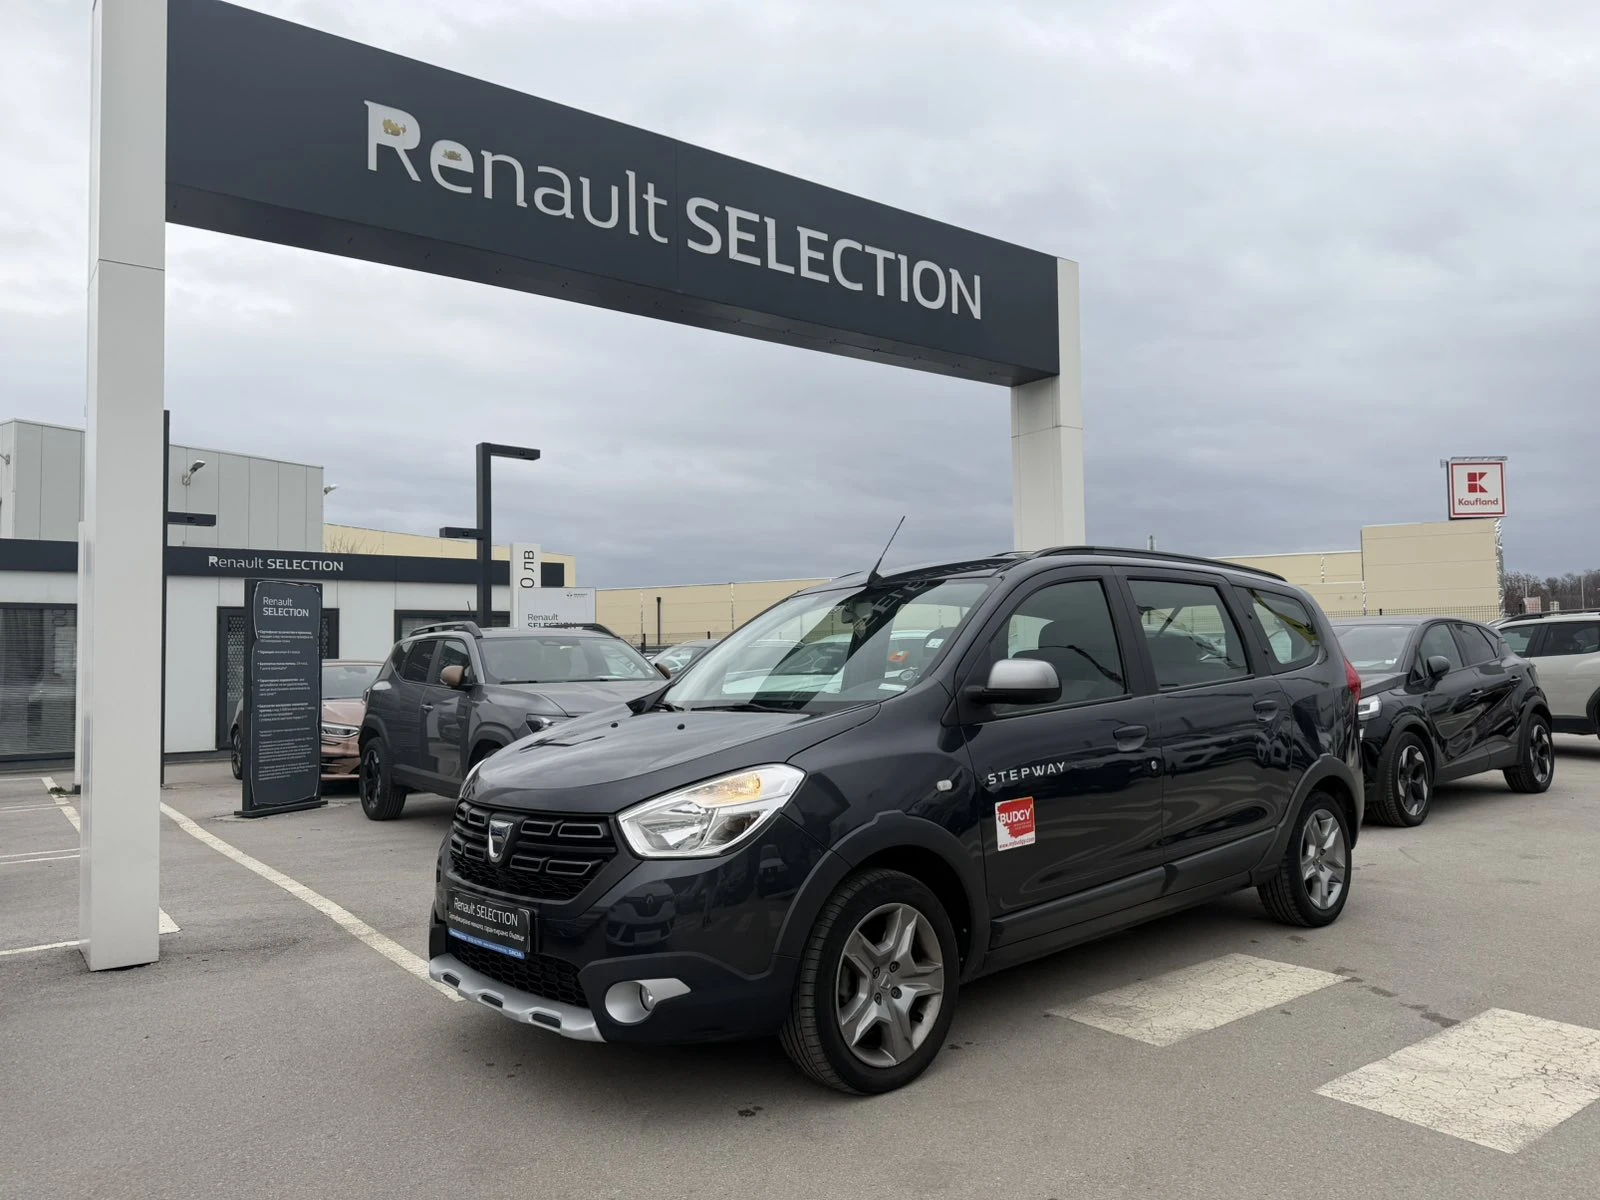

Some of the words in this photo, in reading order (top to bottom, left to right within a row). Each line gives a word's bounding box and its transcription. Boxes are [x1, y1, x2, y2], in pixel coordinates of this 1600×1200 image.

[363, 100, 669, 244] Renault
[685, 196, 983, 320] SELECTION
[1457, 497, 1499, 506] Kaufland
[208, 555, 264, 569] Renault
[267, 558, 344, 572] SELECTION
[262, 596, 293, 607] Renault
[262, 607, 310, 617] SELECTION
[527, 612, 559, 621] Renault
[527, 622, 577, 630] SELEC
[987, 761, 1065, 785] STEPWAY
[999, 807, 1032, 825] BUDGY
[453, 897, 476, 915] Renault
[476, 904, 518, 927] SELECTION
